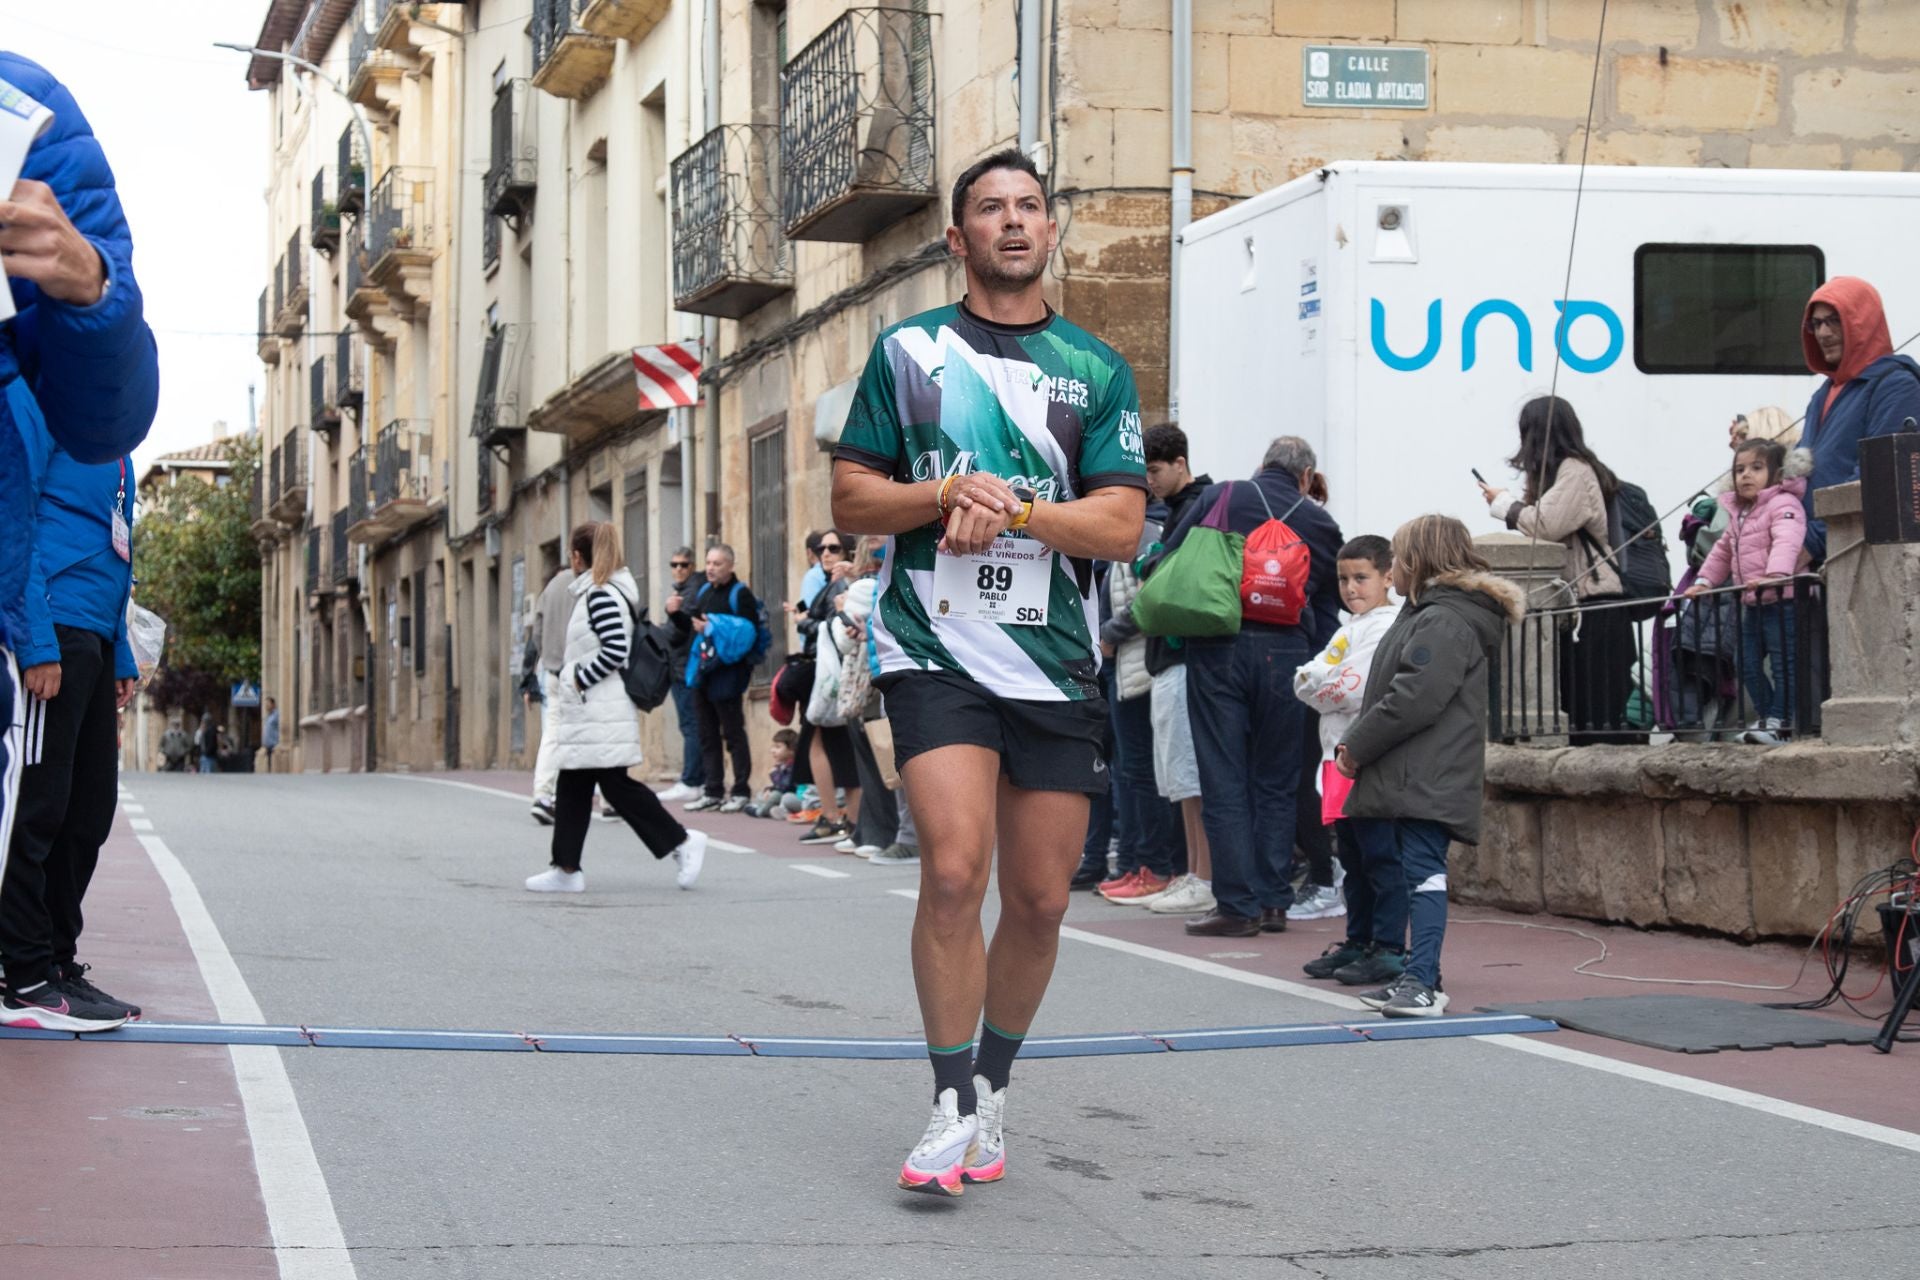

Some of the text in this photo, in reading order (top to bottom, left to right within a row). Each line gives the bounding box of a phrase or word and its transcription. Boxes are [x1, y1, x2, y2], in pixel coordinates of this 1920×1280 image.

[1348, 56, 1389, 72] CALLE
[1307, 81, 1424, 101] SOR ELADIA ARTACHO
[995, 550, 1035, 561] VIÑEDOS
[977, 565, 1013, 591] 89
[979, 591, 1007, 601] PABLO
